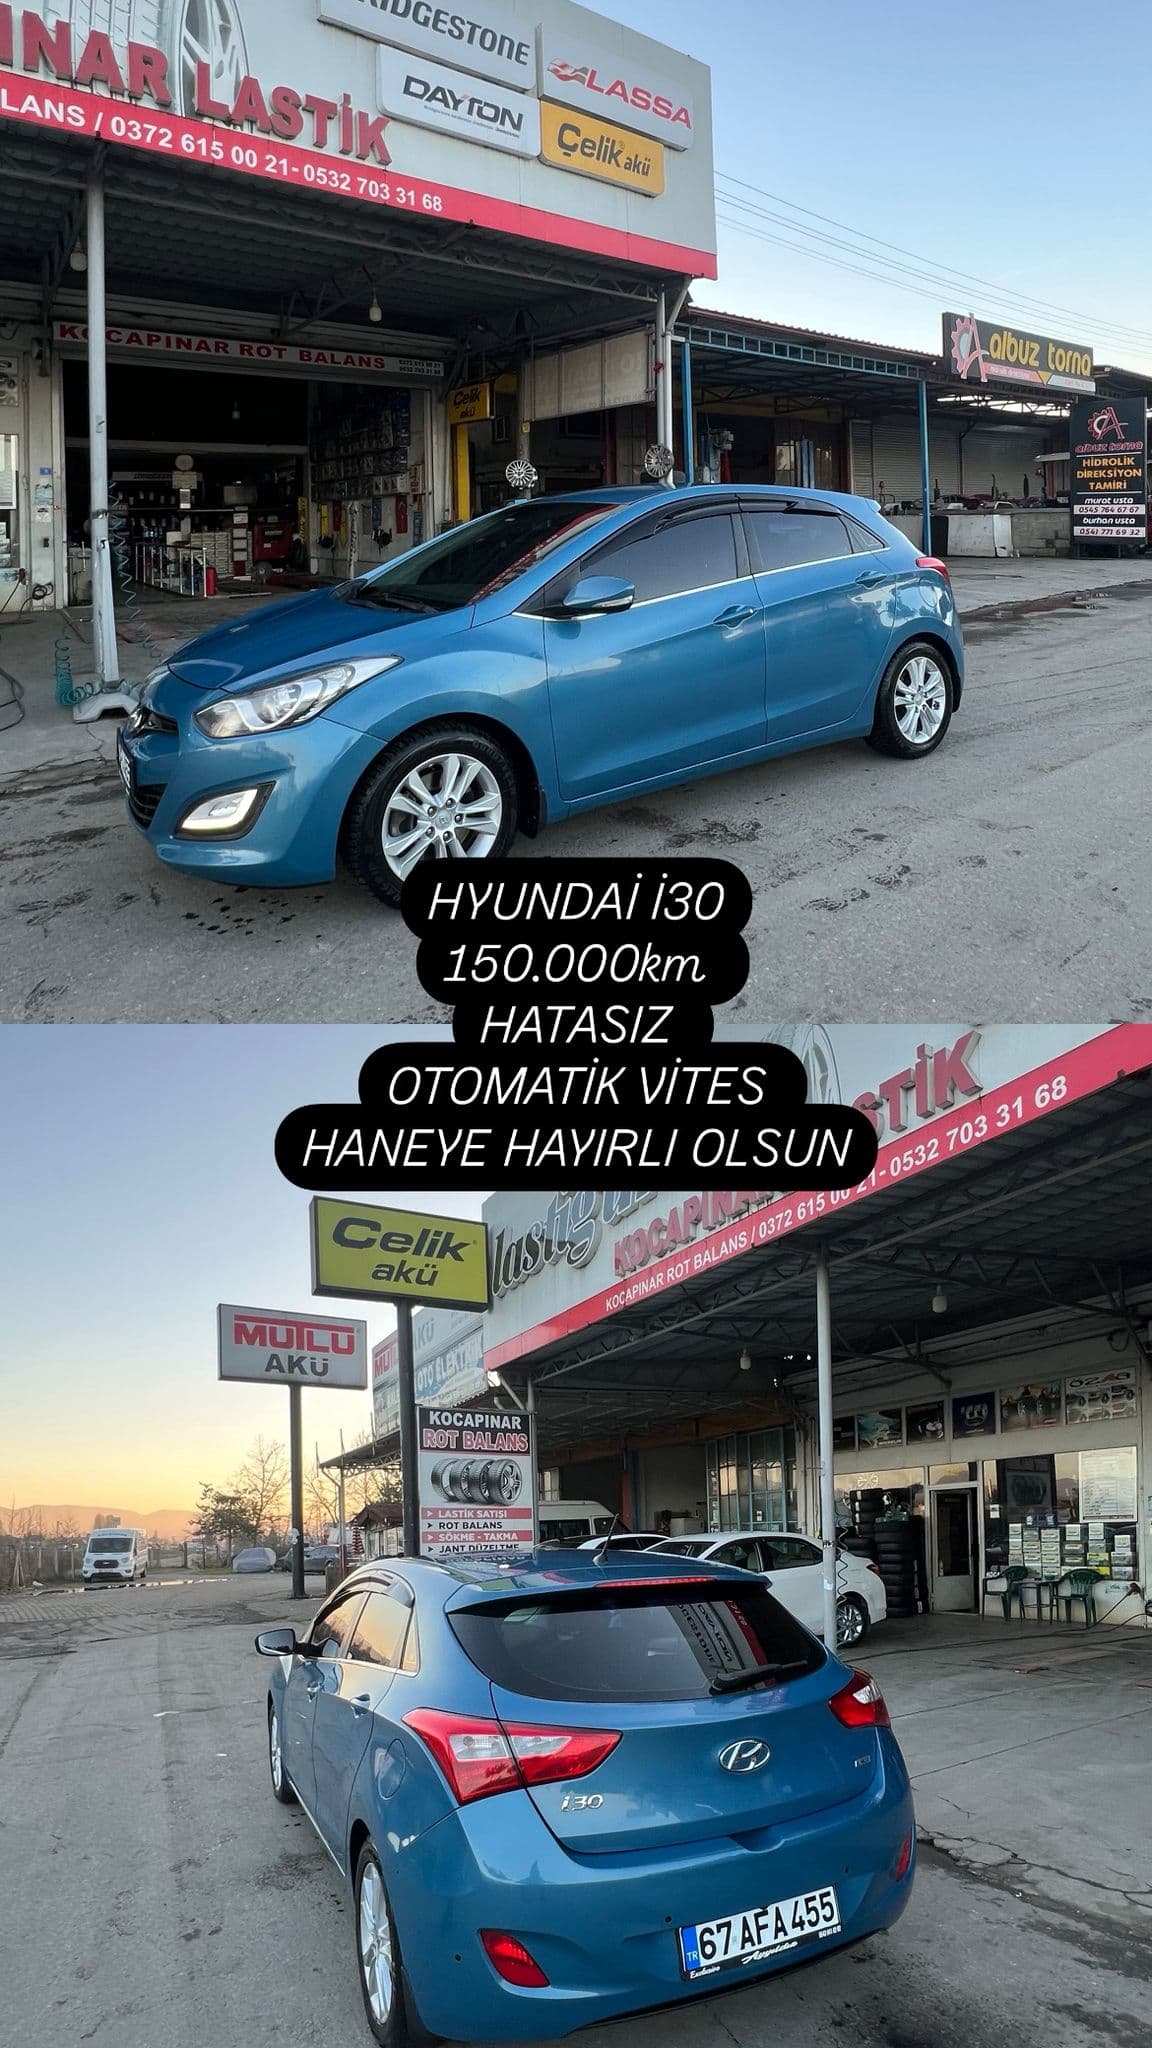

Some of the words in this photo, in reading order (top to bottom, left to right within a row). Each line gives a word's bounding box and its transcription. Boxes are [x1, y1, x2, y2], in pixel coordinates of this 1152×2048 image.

[402, 75, 524, 132] DAYTON
[586, 69, 692, 129] LASSA
[195, 60, 393, 166] LASTİK
[1, 88, 86, 128] LANS
[111, 115, 172, 152] 0372
[181, 133, 224, 160] 615
[230, 145, 258, 169] 00
[356, 176, 391, 201] 703
[395, 186, 416, 206] 31
[422, 192, 443, 213] 68
[557, 122, 624, 168] Çelik
[623, 154, 652, 177] akü
[239, 343, 287, 359] ROT
[299, 350, 386, 369] BALANS
[989, 331, 1040, 366] albuz
[1047, 342, 1091, 377] torna
[454, 387, 480, 410] Çelik
[1082, 456, 1135, 467] HİDROLİK
[1076, 468, 1142, 479] DİREKSİYON
[1088, 480, 1127, 490] TAMİRİ
[1083, 517, 1113, 525] burhan
[1115, 517, 1136, 525] usta
[605, 1272, 664, 1312] KOCAPINAR
[666, 1259, 691, 1283] ROT
[693, 1232, 747, 1272] BALANS
[758, 1208, 793, 1239] 0372
[797, 1192, 825, 1220] 615
[946, 1116, 988, 1151] 703
[995, 1095, 1024, 1128] 31
[1034, 1075, 1067, 1108] 68
[372, 1260, 438, 1287] akü
[234, 1314, 355, 1356] MUTLU
[265, 1354, 329, 1377] AKÜ
[429, 1411, 522, 1430] KOCAPINAR
[422, 1428, 459, 1448] ROT
[463, 1429, 528, 1452] BALANS
[438, 1509, 474, 1518] LASTİK
[438, 1522, 459, 1530] ROT
[438, 1531, 475, 1541] SÖKME
[484, 1532, 518, 1541] TAKMA
[439, 1544, 465, 1553] JANT
[561, 1794, 604, 1812] i30
[698, 1920, 732, 1961] 67
[740, 1907, 788, 1950] AFA
[791, 1891, 835, 1932] 455
[687, 1951, 698, 1962] TR
